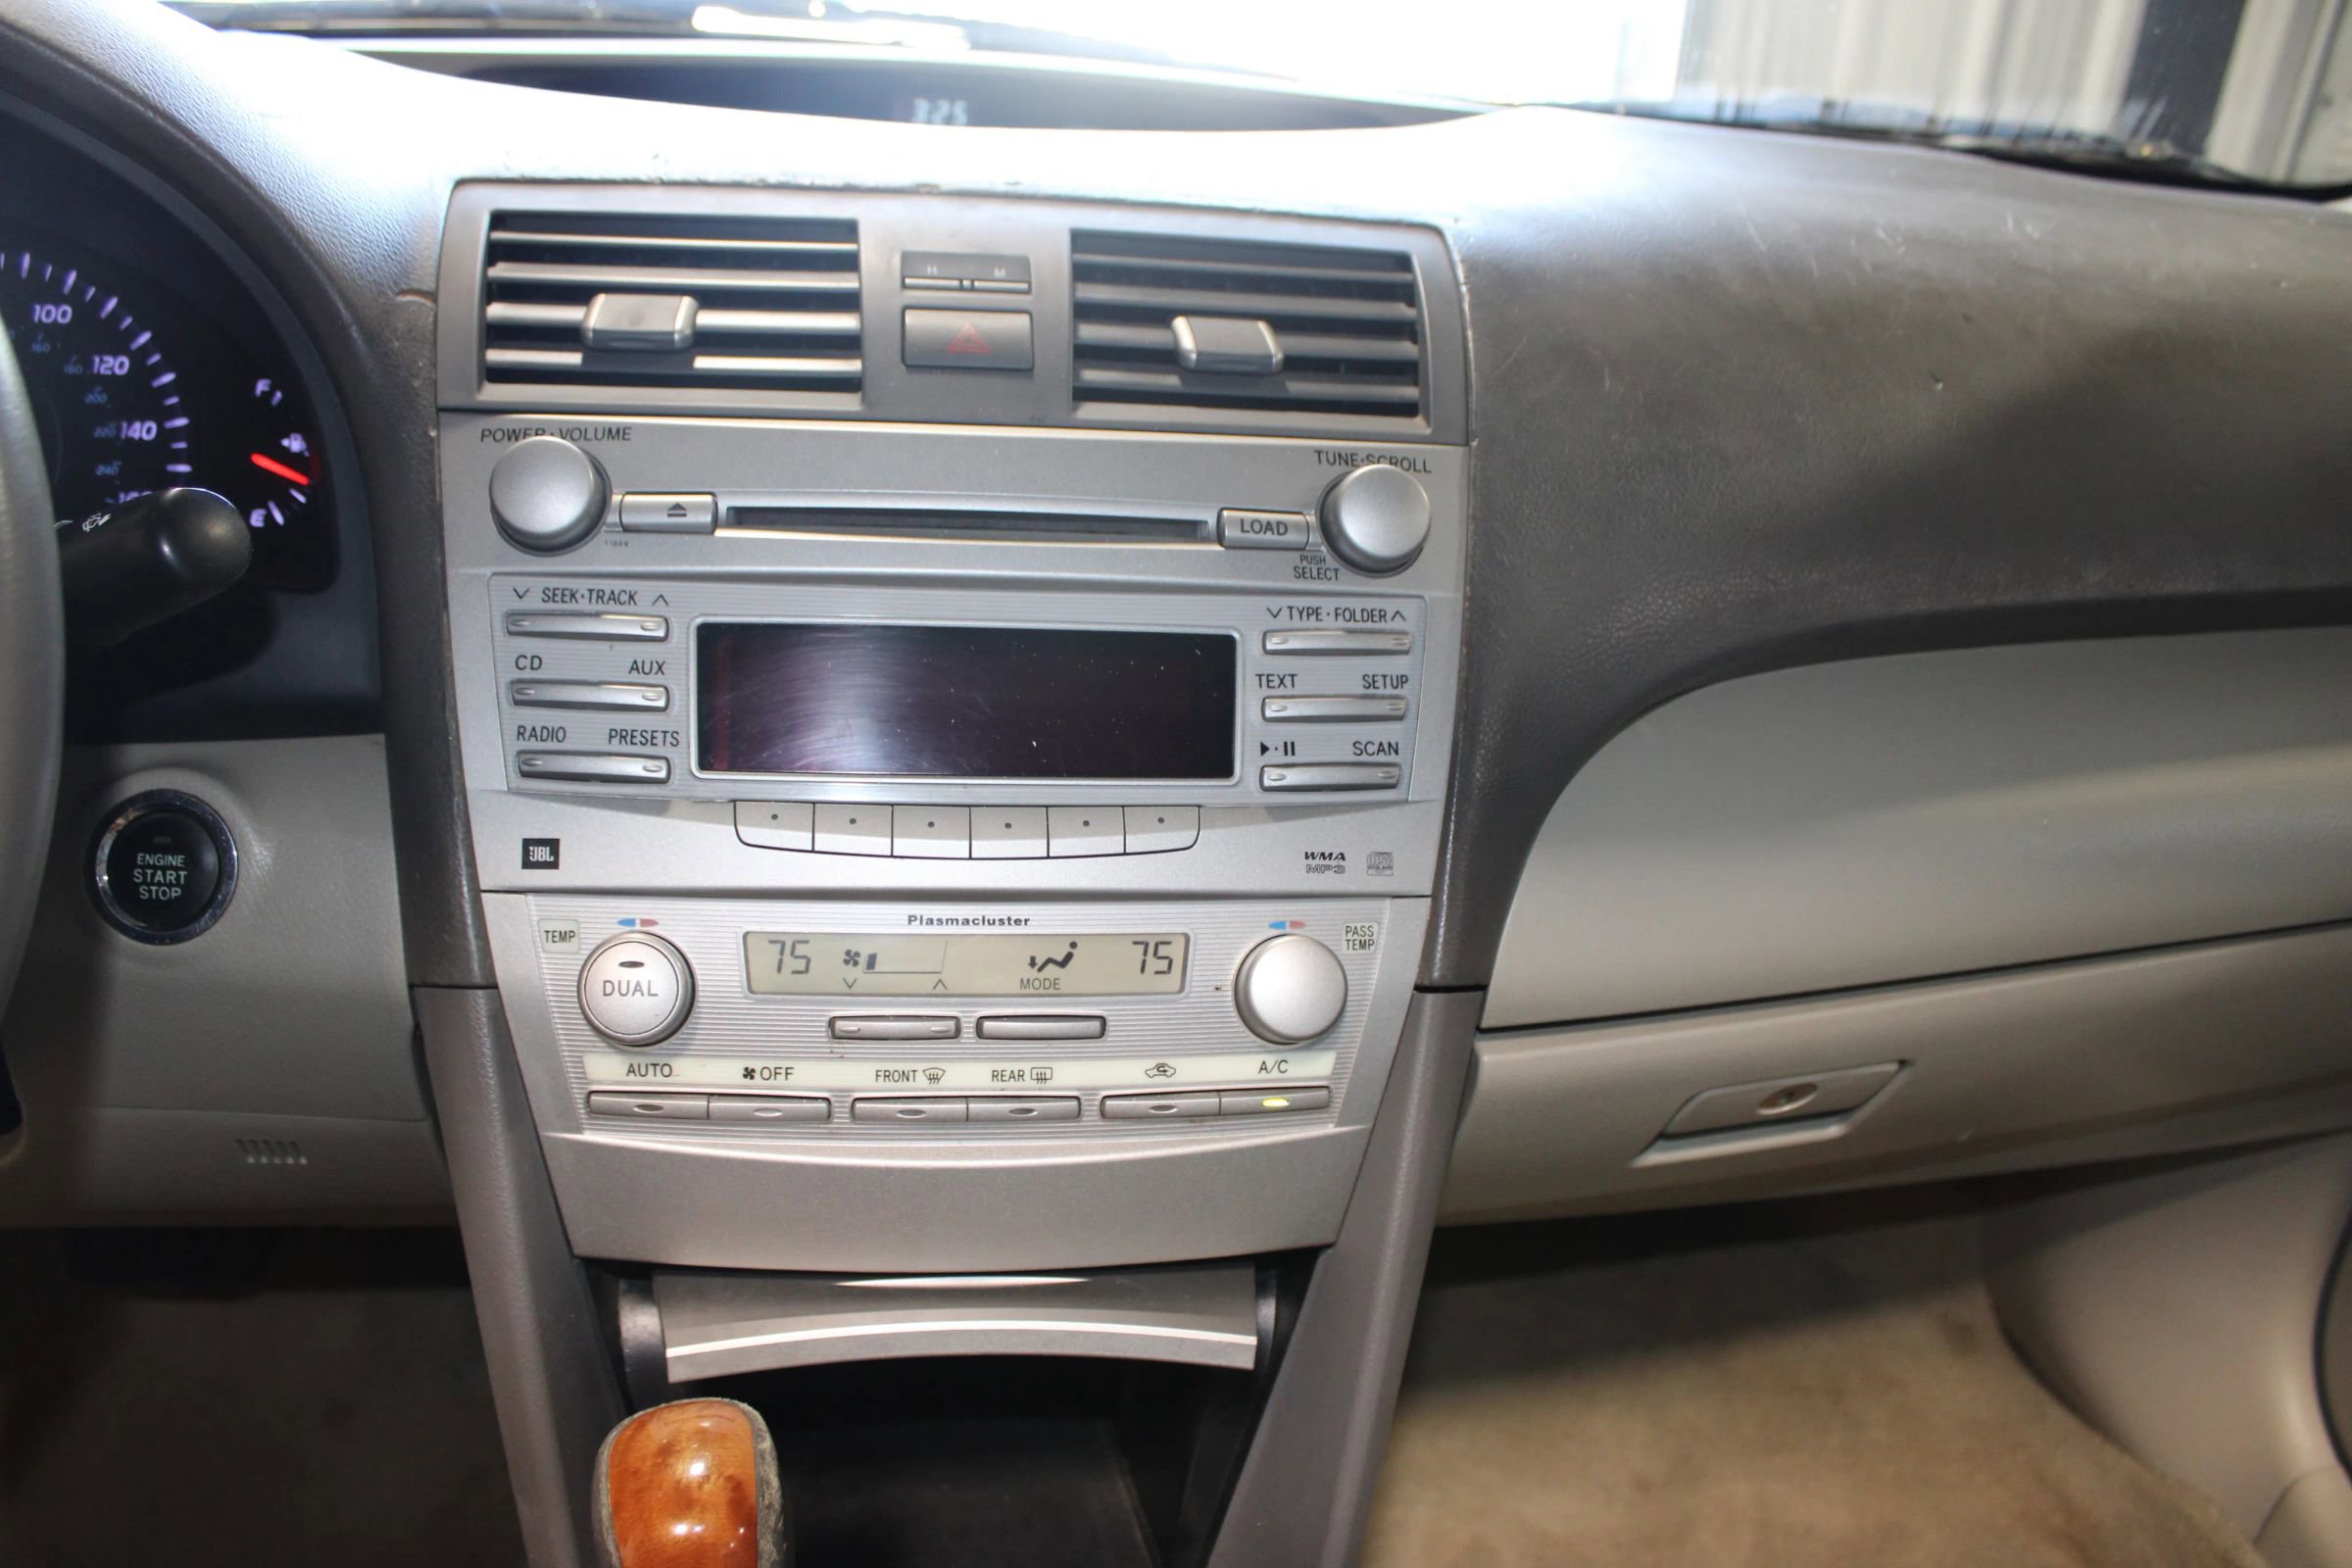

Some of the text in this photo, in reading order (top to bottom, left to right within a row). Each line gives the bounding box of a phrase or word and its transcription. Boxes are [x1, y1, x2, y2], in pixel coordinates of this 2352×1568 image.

[927, 266, 938, 275] H
[994, 268, 1005, 278] M
[32, 304, 74, 324] 100
[92, 355, 130, 376] 120
[255, 378, 272, 397] F
[120, 420, 158, 442] 140
[249, 508, 267, 527] E
[1240, 517, 1288, 536] LOAD
[1299, 555, 1326, 565] PUSH
[1294, 567, 1340, 581] SELECT
[514, 654, 543, 671] CD
[628, 660, 666, 676] AUX
[1255, 673, 1298, 690] TEXT
[1362, 674, 1409, 690] SETUP
[516, 725, 567, 743] RADIO
[608, 728, 680, 748] PRESETS
[1352, 741, 1399, 757] SCAN
[136, 853, 186, 867] ENGINE
[528, 846, 555, 862] JBL
[1304, 851, 1347, 861] WMA
[132, 868, 188, 885] START
[1305, 863, 1347, 874] MP3
[139, 885, 182, 901] STOP
[907, 914, 1031, 927] Plasmacluster
[544, 930, 576, 944] TEMP
[1345, 925, 1375, 938] PASS
[1346, 939, 1375, 952] TEMP
[767, 939, 811, 975] 75
[1132, 941, 1174, 975] 75
[602, 979, 660, 998] DUAL
[1020, 978, 1061, 991] MODE
[626, 1063, 673, 1078] AUTO
[760, 1066, 795, 1081] OFF
[1258, 1059, 1289, 1074] A/C
[875, 1069, 917, 1083] FRONT
[992, 1069, 1026, 1083] REAR
